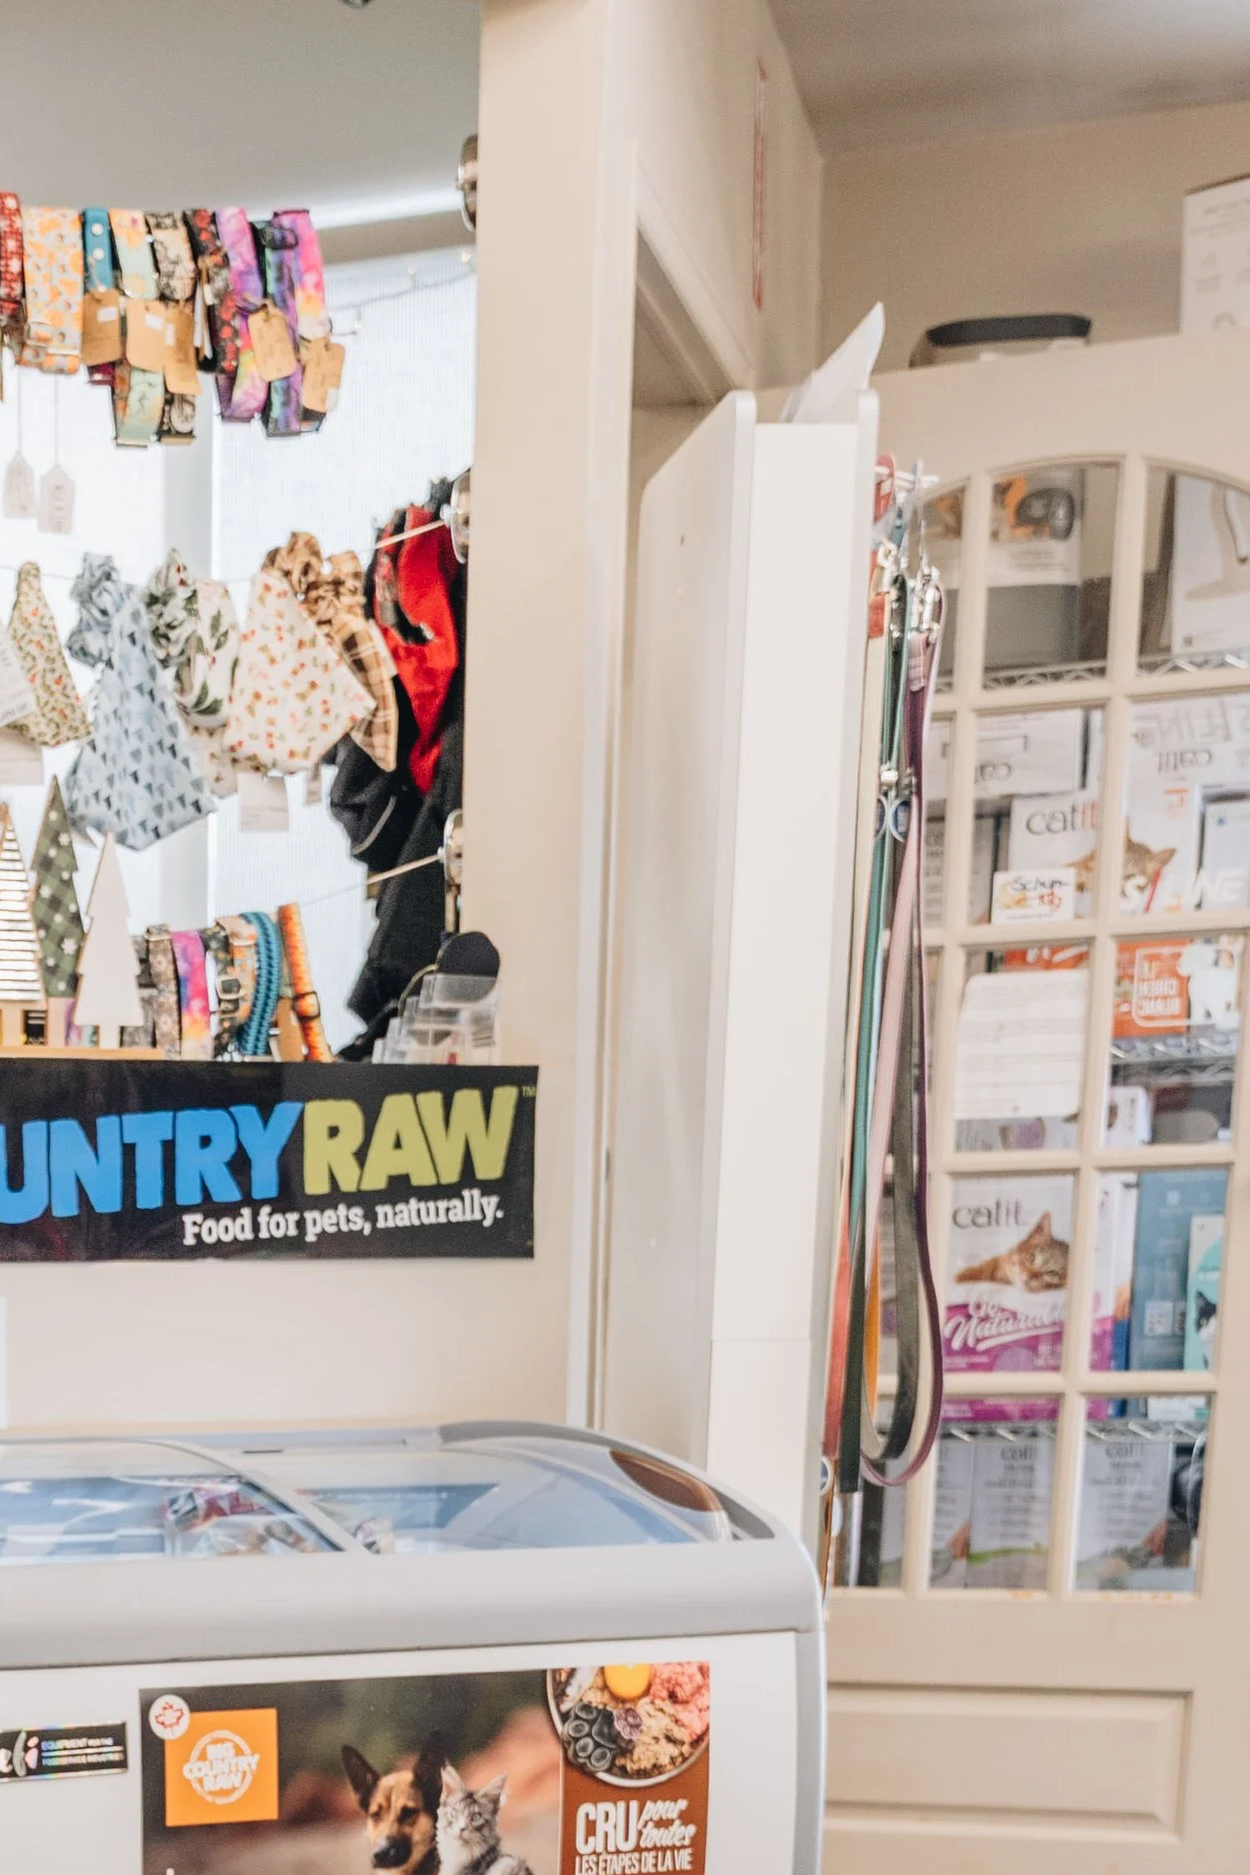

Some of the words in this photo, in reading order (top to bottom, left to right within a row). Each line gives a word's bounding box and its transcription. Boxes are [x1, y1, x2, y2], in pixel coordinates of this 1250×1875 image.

[303, 1084, 519, 1196] RAW
[182, 1206, 255, 1246] Food
[257, 1204, 300, 1239] for
[303, 1201, 372, 1243] pets,
[375, 1187, 505, 1229] naturally.
[182, 1752, 261, 1781] COUNTRY
[575, 1799, 639, 1856] CRU
[636, 1797, 691, 1832] pour
[639, 1819, 698, 1849] toutes
[641, 1851, 658, 1874] DE
[658, 1850, 673, 1873] LA
[674, 1847, 693, 1872] VIE
